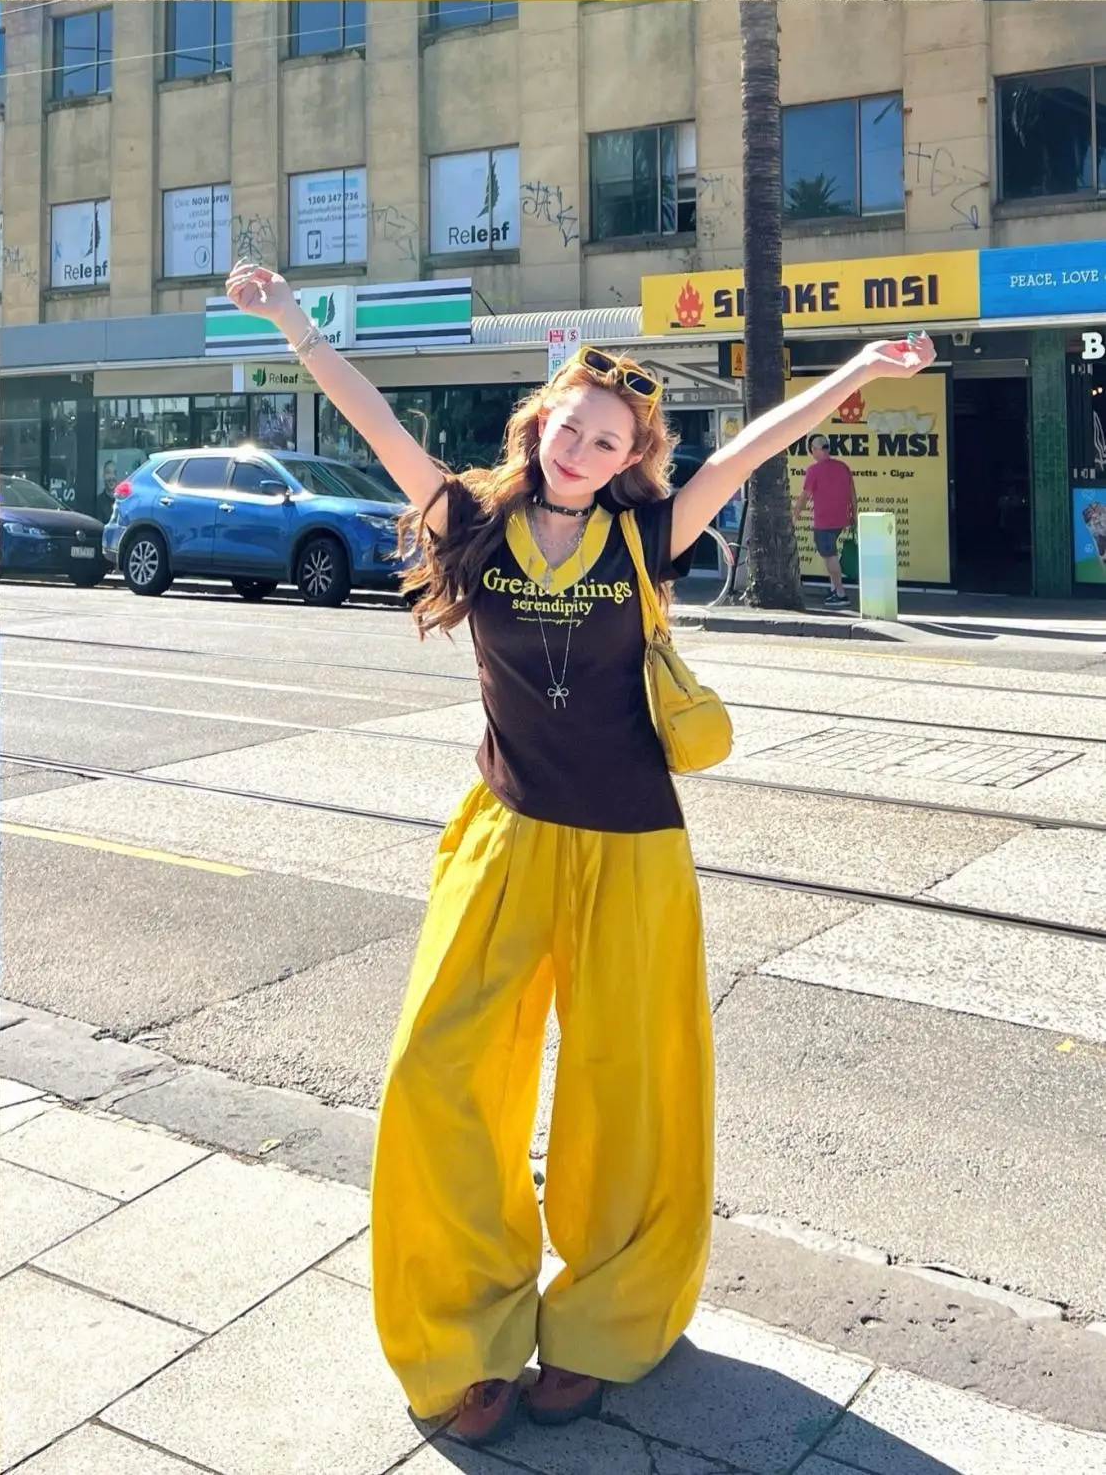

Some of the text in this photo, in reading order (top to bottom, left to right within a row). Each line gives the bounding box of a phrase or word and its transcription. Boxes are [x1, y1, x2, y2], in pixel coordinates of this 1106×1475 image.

[191, 196, 210, 206] NOW
[448, 221, 510, 246] Releaf
[64, 260, 108, 280] Releaf
[1009, 269, 1099, 288] PEACE, LOVE
[713, 274, 940, 318] SKE MSI
[269, 372, 299, 384] Releaf
[877, 433, 939, 457] MSI
[512, 598, 594, 617] serendipity
